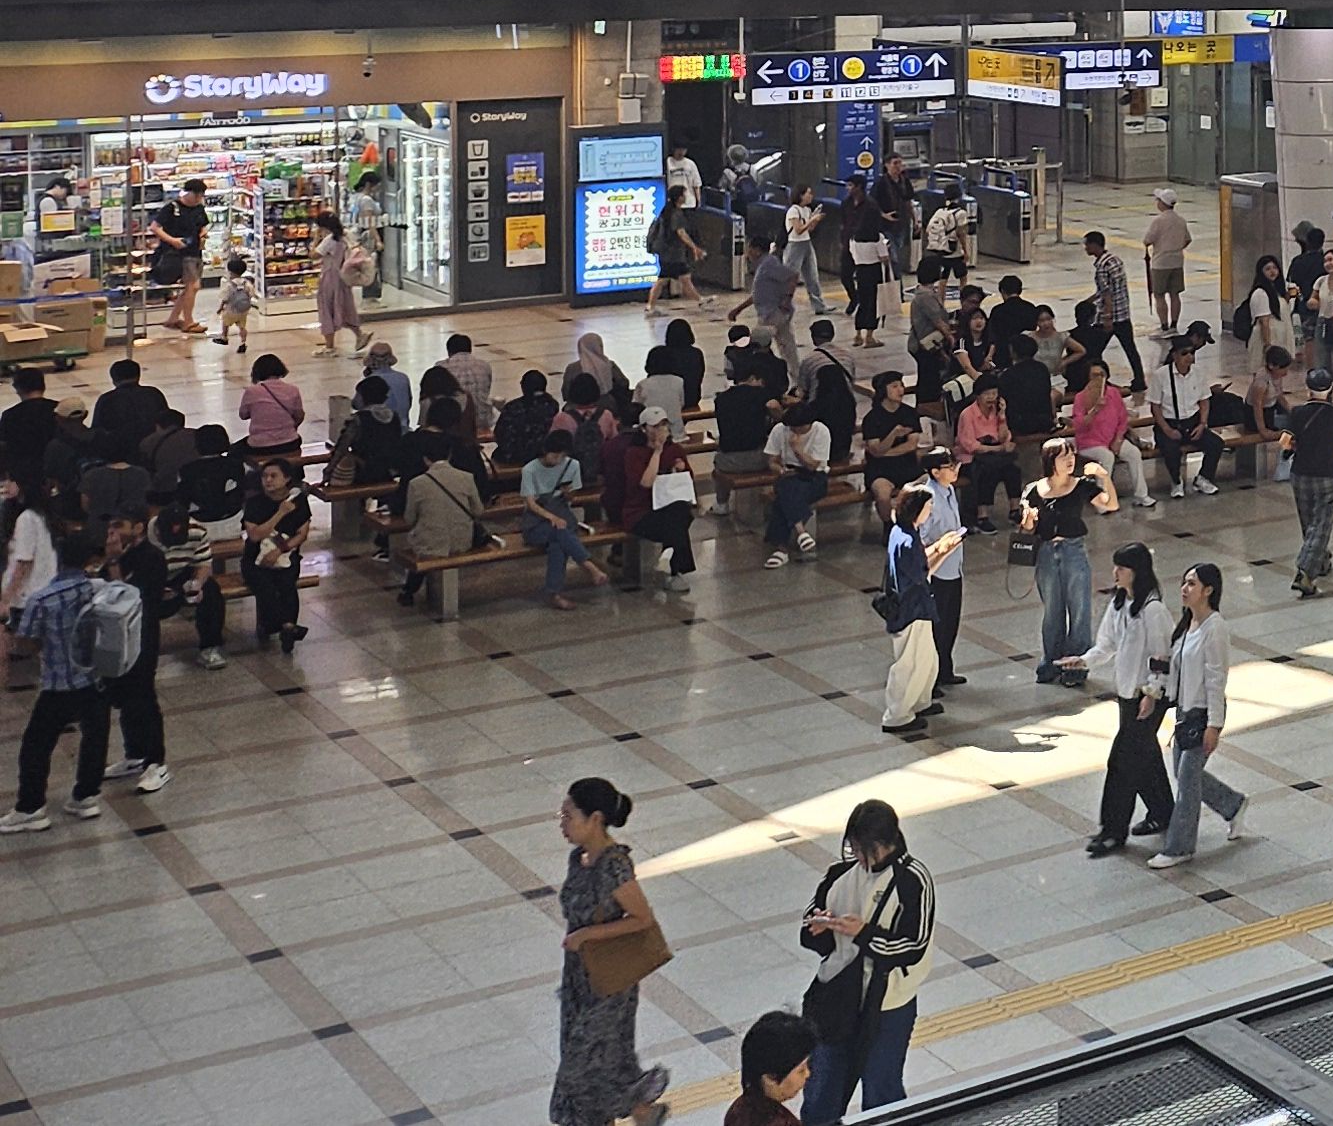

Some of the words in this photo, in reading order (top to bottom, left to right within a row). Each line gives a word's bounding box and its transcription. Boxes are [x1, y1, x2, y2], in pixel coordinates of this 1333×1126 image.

[1164, 42, 1197, 53] 나오는
[1206, 41, 1217, 54] 곳
[183, 72, 328, 100] StoryWay
[482, 112, 527, 122] StoryWay
